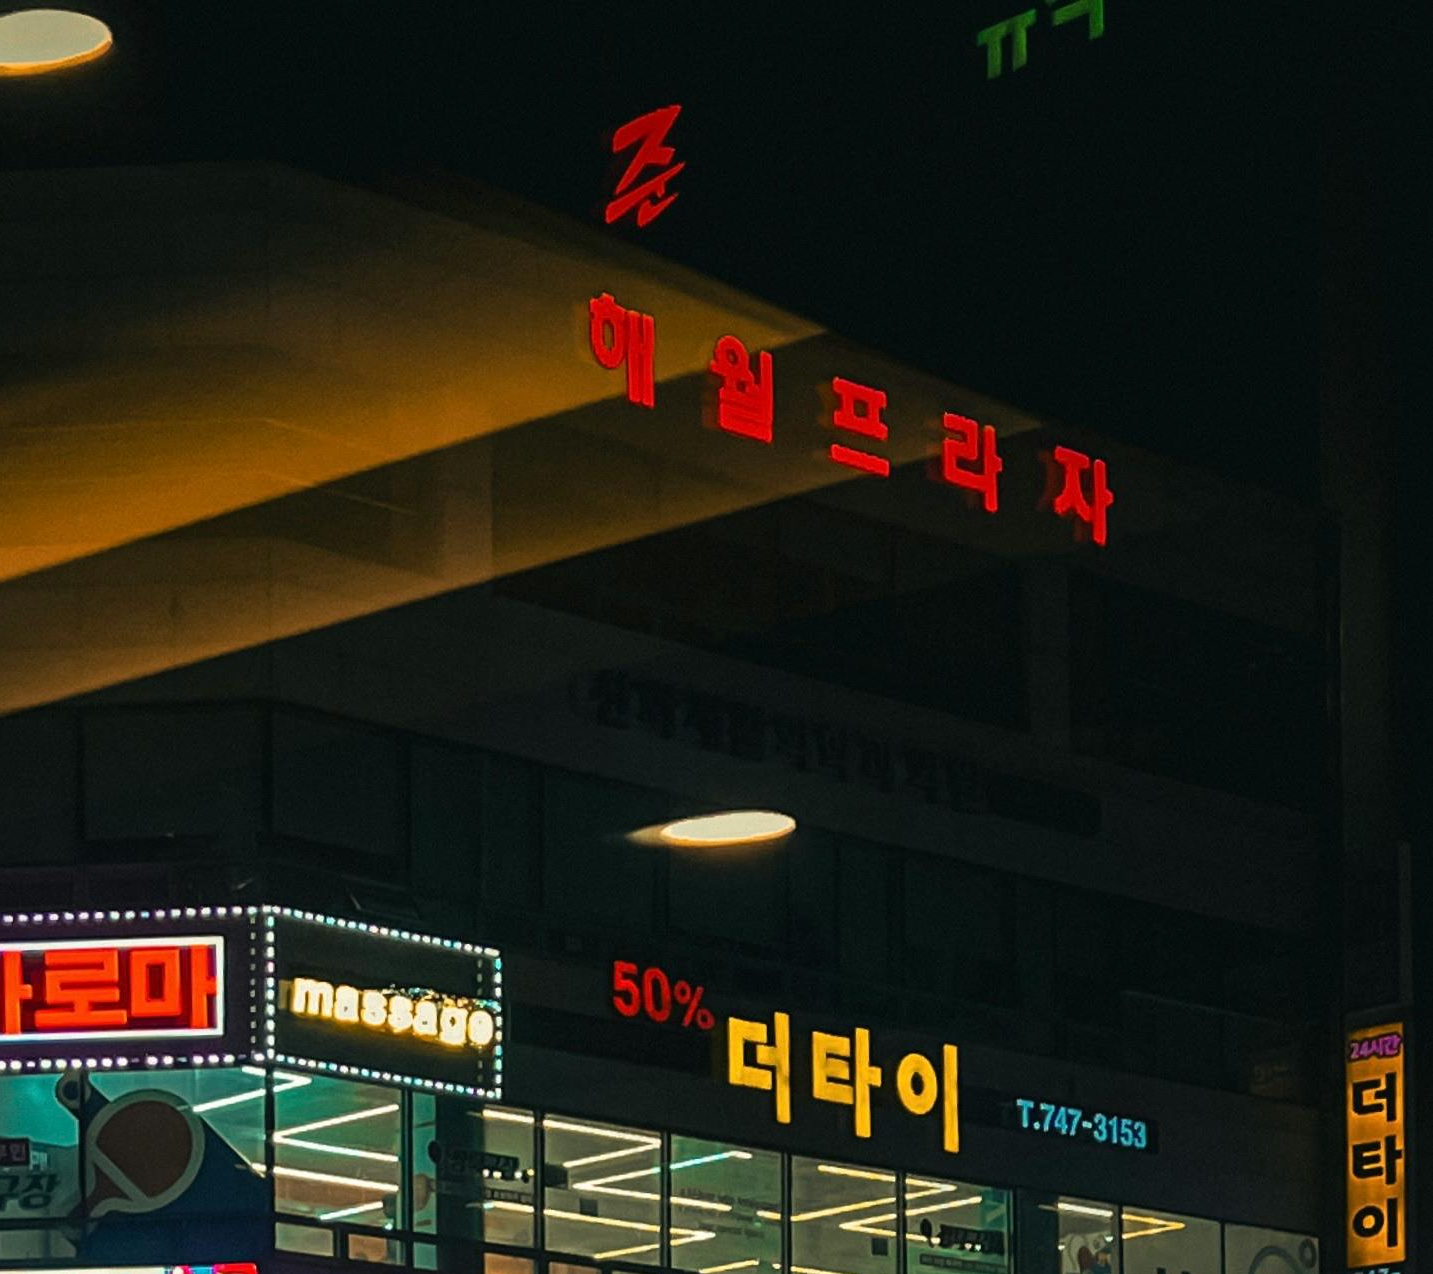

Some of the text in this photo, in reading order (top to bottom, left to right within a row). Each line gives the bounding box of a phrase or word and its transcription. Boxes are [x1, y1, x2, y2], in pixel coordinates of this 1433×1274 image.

[612, 960, 715, 1031] 50%
[727, 1012, 959, 1153] 더타이
[1016, 1098, 1148, 1149] T.747-3153
[1352, 1071, 1403, 1251] 더타이
